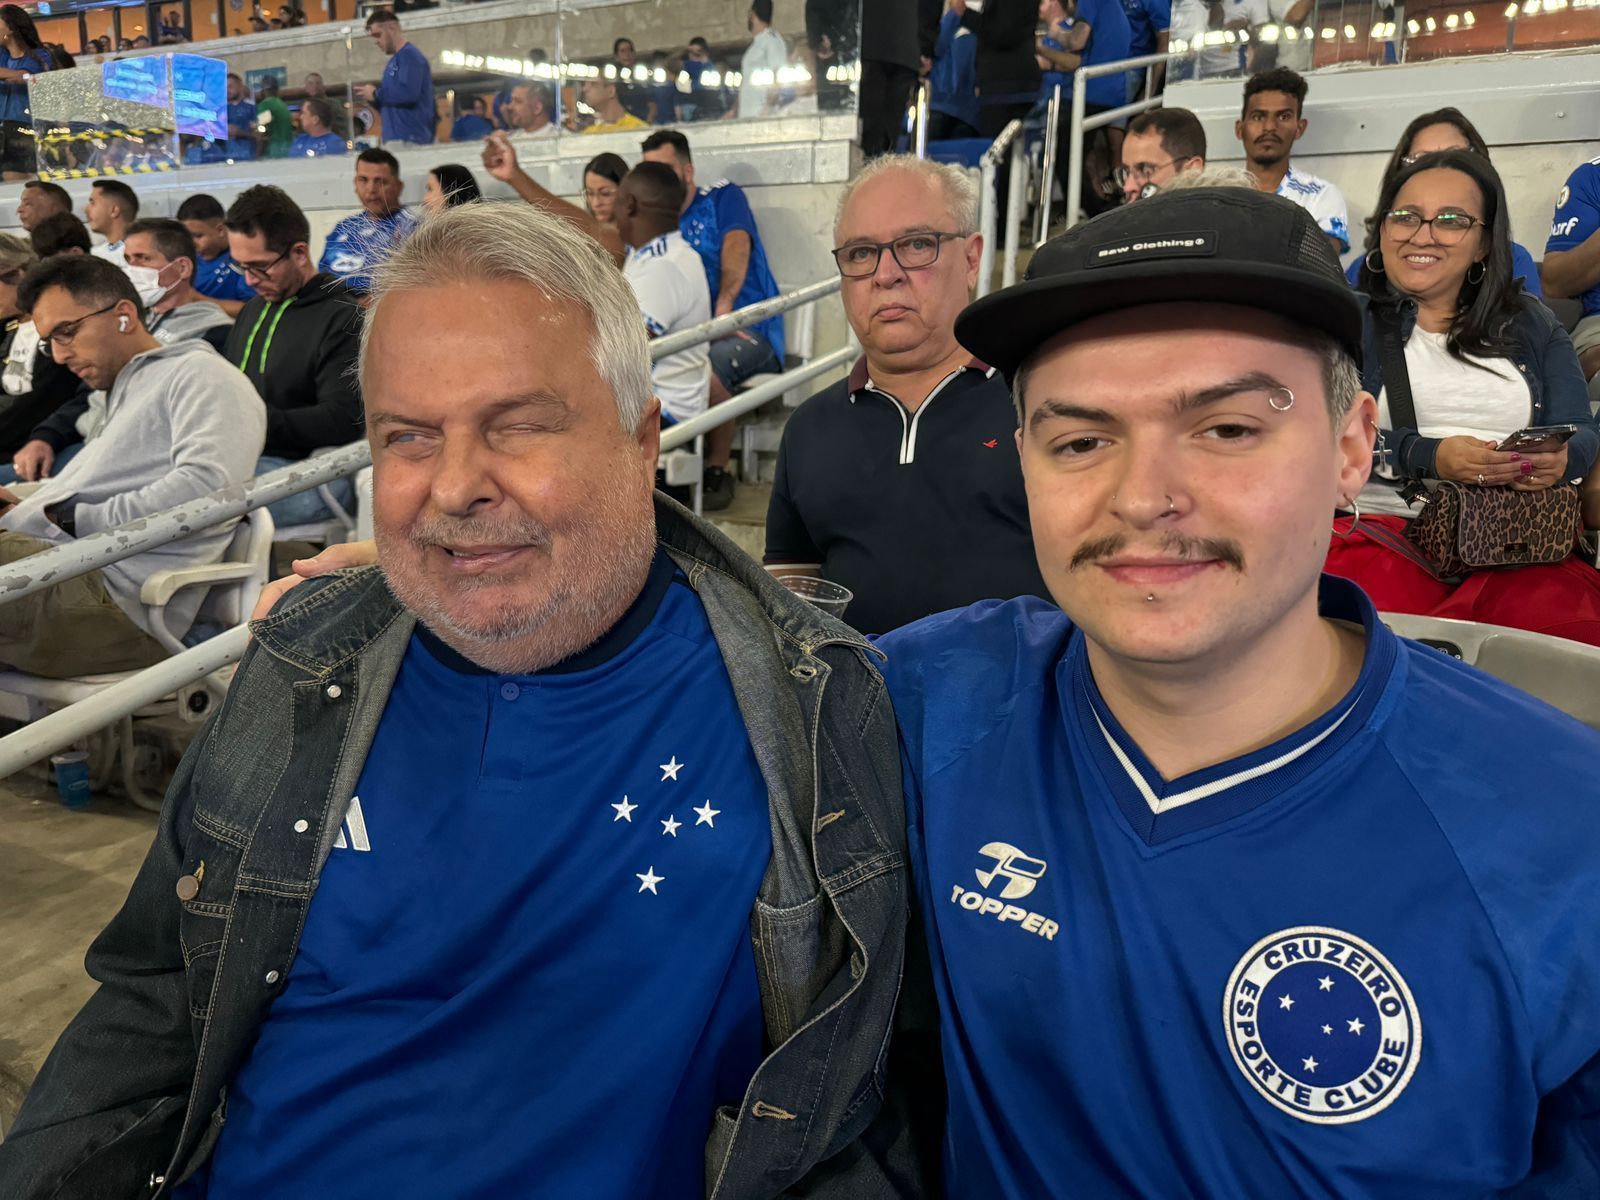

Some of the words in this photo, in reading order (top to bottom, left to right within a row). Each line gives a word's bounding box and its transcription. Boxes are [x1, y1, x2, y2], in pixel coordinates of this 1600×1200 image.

[950, 884, 1060, 941] TOPPER
[1264, 939, 1402, 1018] CRUZEIRO
[1236, 978, 1312, 1107] ESPORTE
[1324, 1038, 1405, 1110] CLUBE
